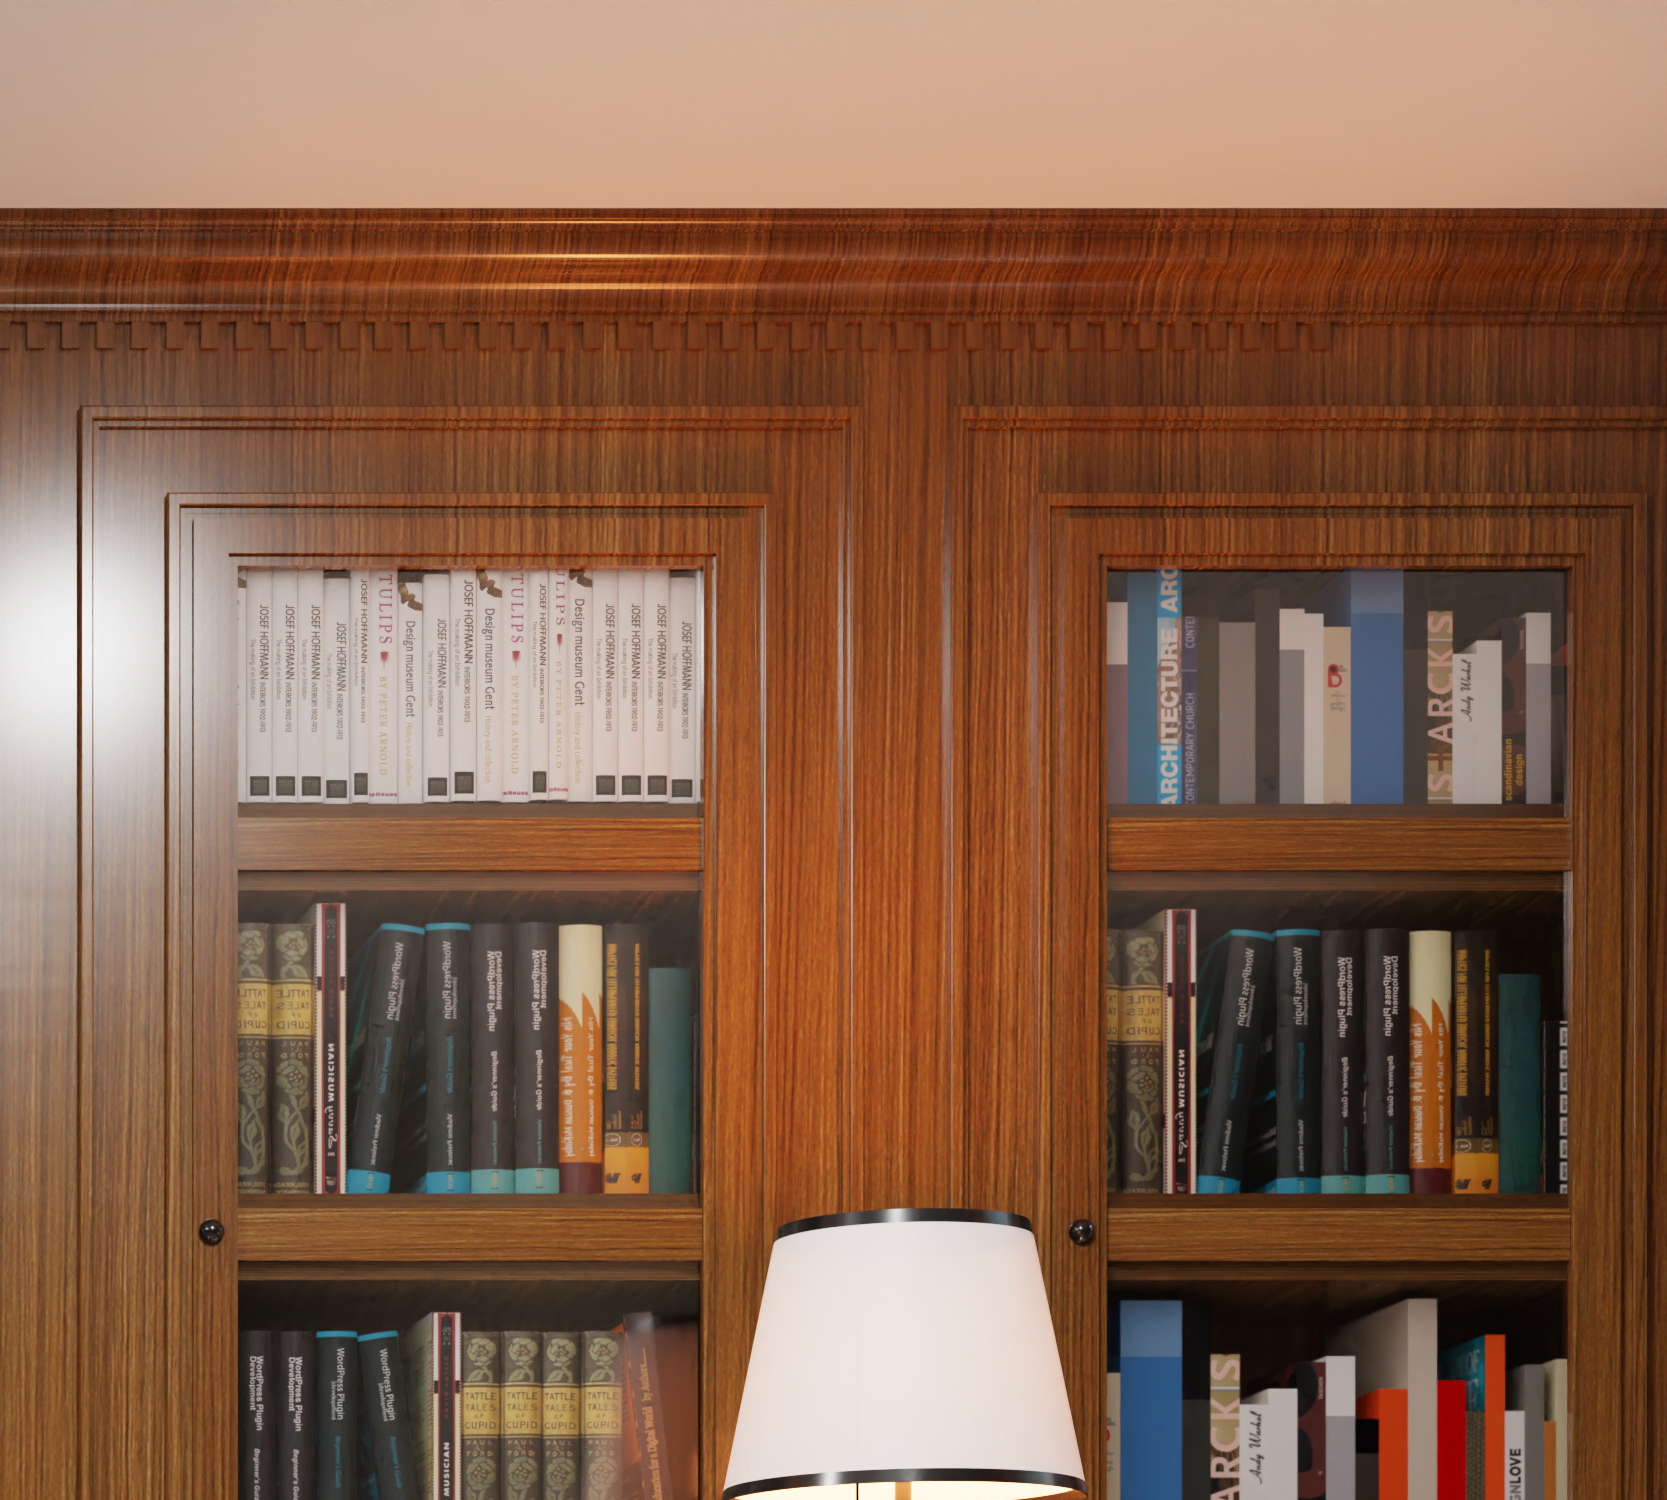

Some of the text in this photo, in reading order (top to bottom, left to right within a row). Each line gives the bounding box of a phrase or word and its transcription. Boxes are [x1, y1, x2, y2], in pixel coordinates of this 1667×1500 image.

[377, 572, 394, 643] TULIPS
[483, 609, 495, 640] Design
[485, 687, 495, 709] Gent
[1159, 627, 1179, 804] ARCHITECTURE
[1249, 1411, 1264, 1483] Andy Warhol
